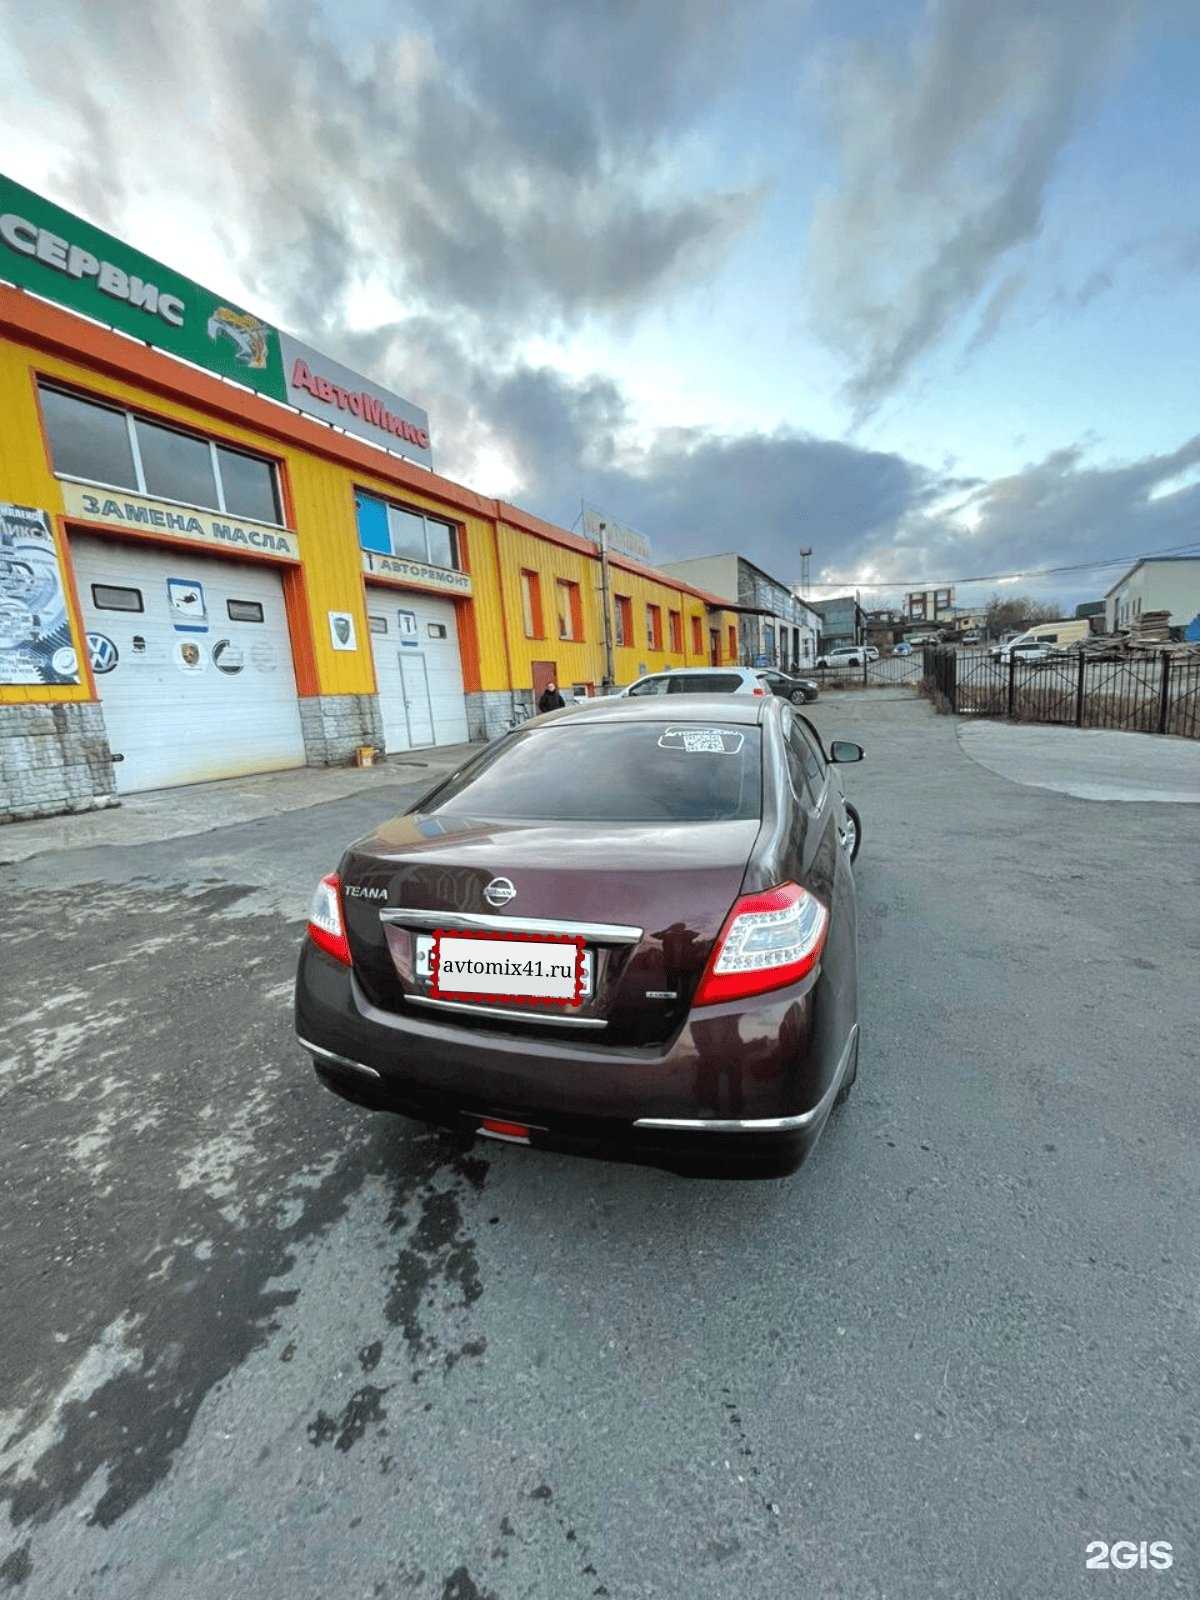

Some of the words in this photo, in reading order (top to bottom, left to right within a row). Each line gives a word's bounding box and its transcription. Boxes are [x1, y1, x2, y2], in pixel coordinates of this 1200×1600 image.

[0, 213, 185, 328] СЕРВИС
[82, 494, 204, 536] ЗАМЕНА
[212, 522, 291, 553] МАСЛА
[380, 559, 470, 588] АВТОРЕМОНТ
[344, 885, 389, 900] TEANA
